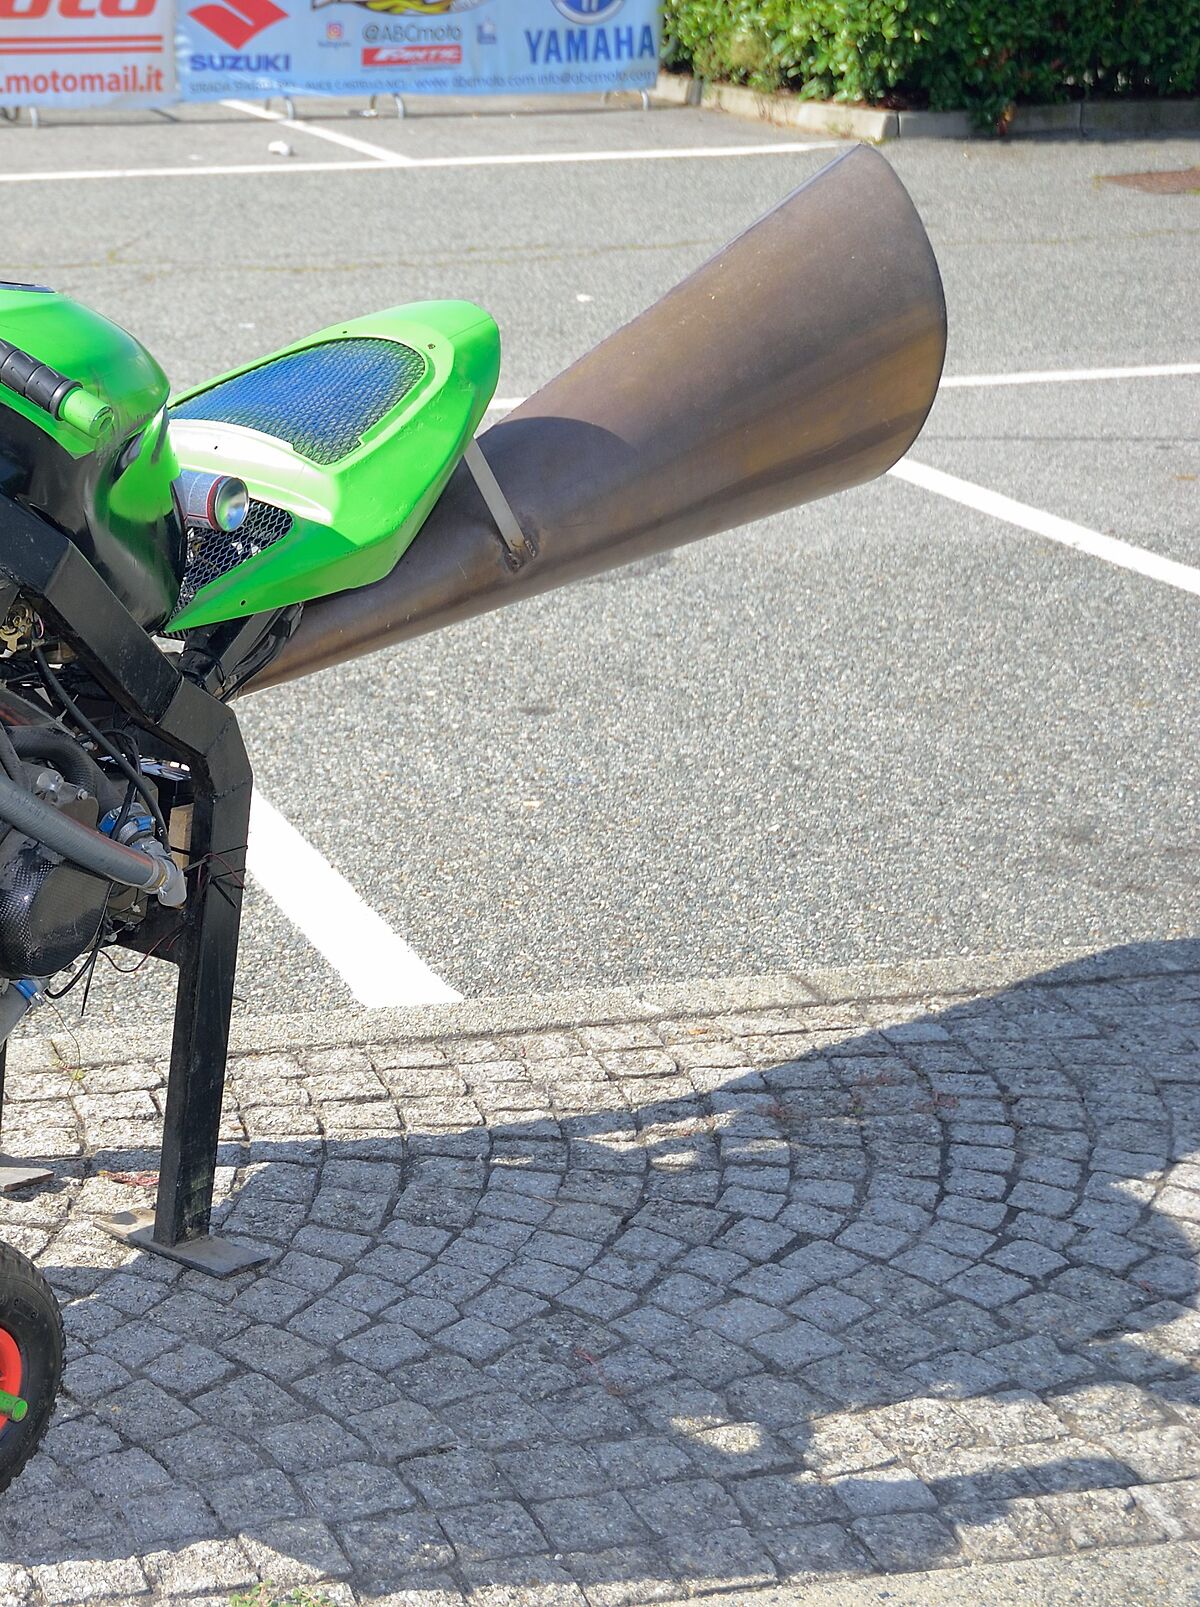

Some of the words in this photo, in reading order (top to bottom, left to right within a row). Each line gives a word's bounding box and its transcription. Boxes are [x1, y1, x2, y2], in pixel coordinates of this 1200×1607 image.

[362, 22, 463, 43] @ABCmoto
[525, 25, 656, 64] YAMAHA
[189, 54, 291, 72] SUZUKI
